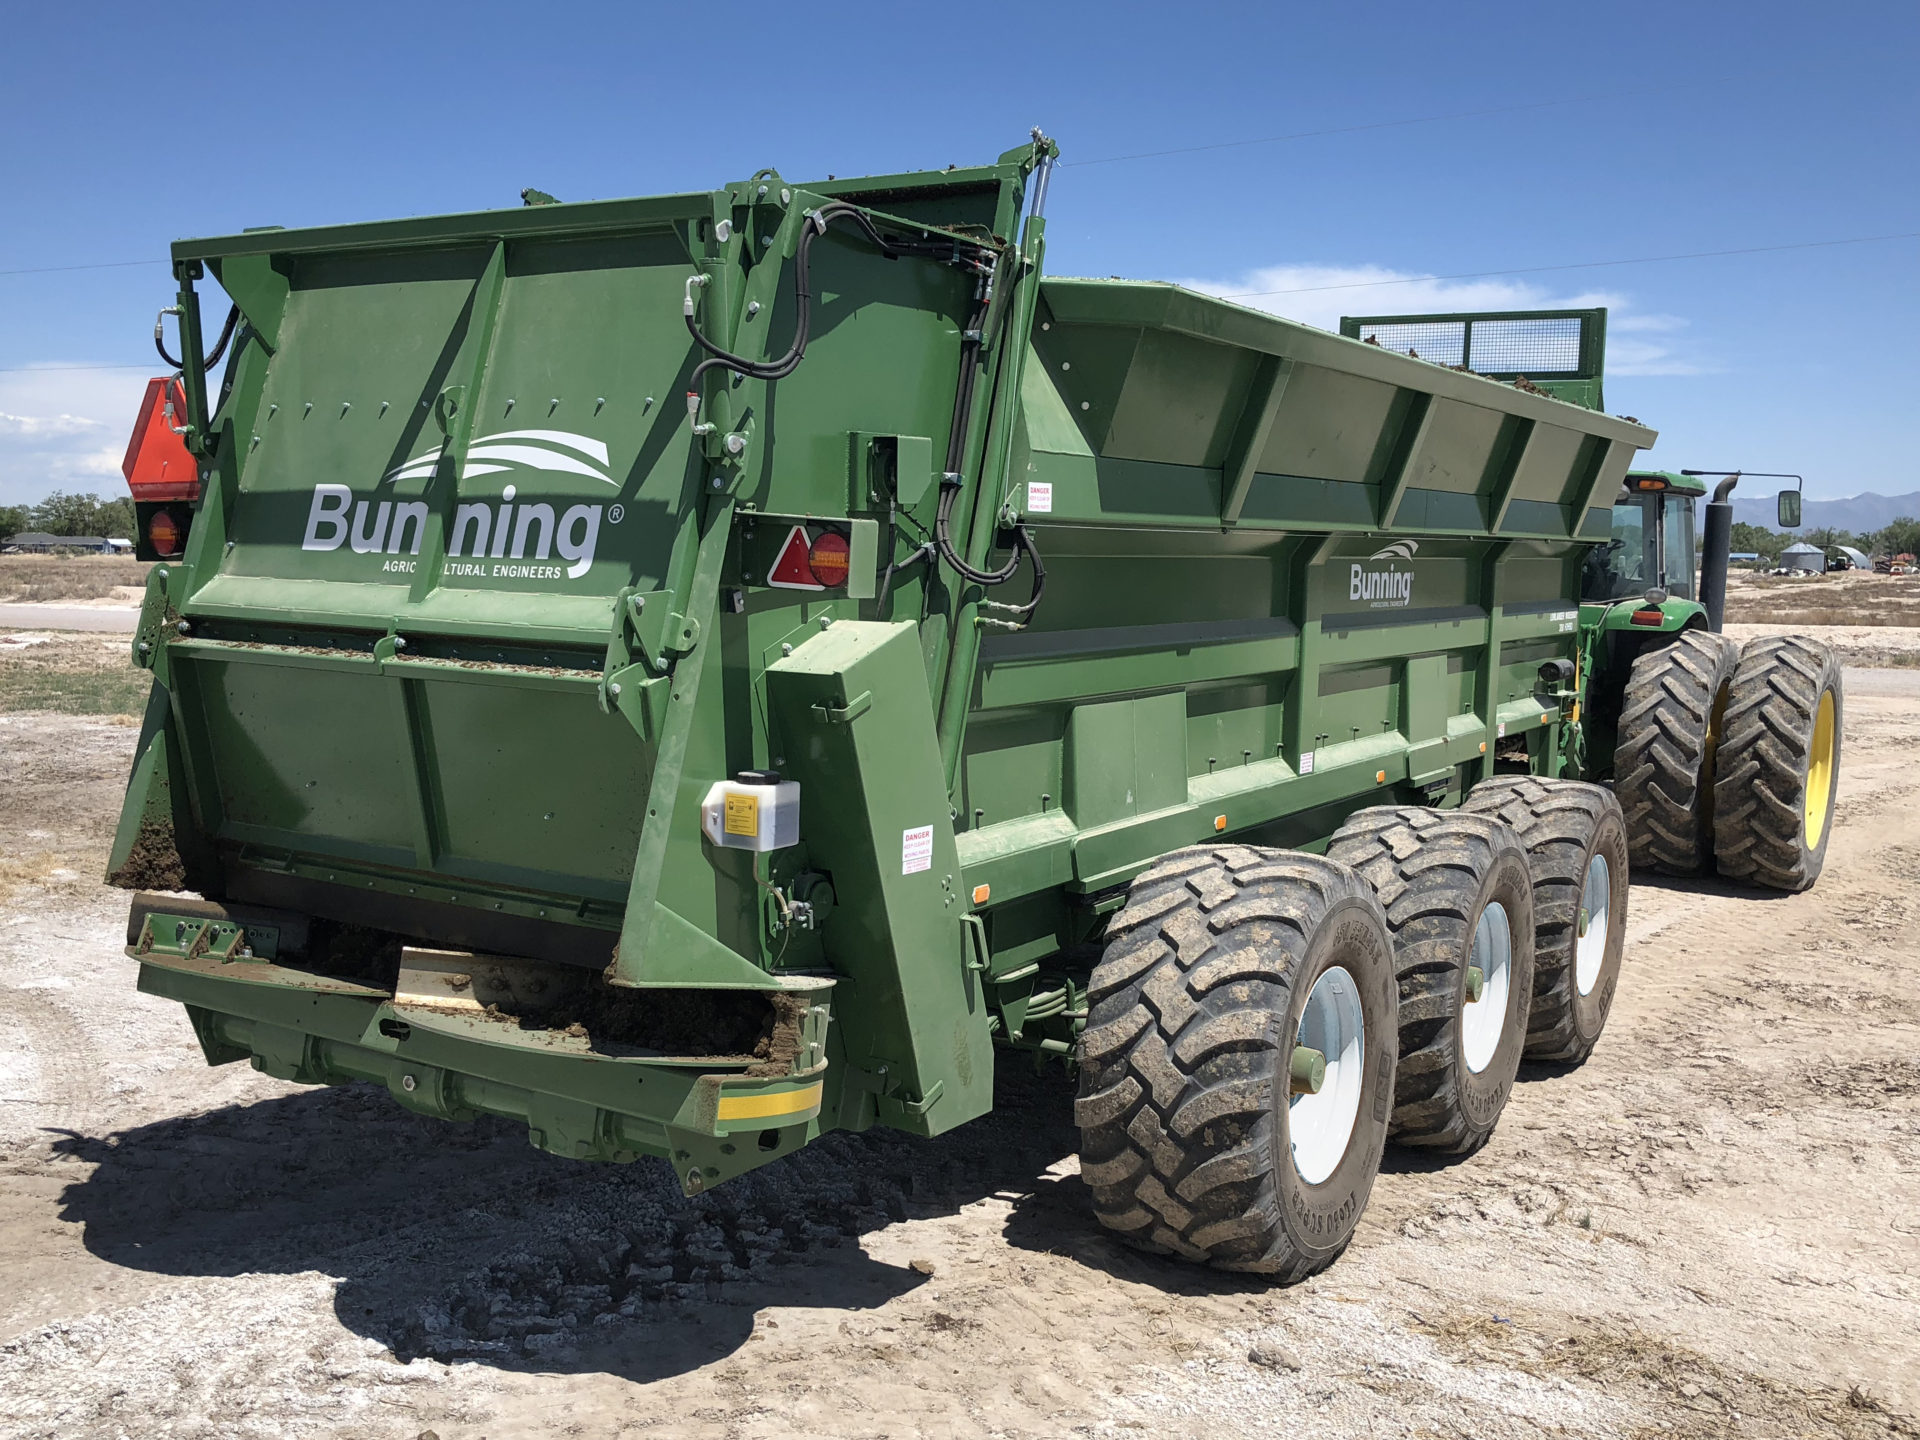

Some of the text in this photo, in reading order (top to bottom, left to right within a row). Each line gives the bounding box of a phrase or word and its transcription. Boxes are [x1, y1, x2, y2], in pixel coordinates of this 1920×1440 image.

[302, 483, 603, 579] Bunning
[382, 560, 562, 579] AGRICLTURAL ENGINEERS
[1349, 563, 1411, 606] Bunning
[905, 830, 930, 842] DANGER
